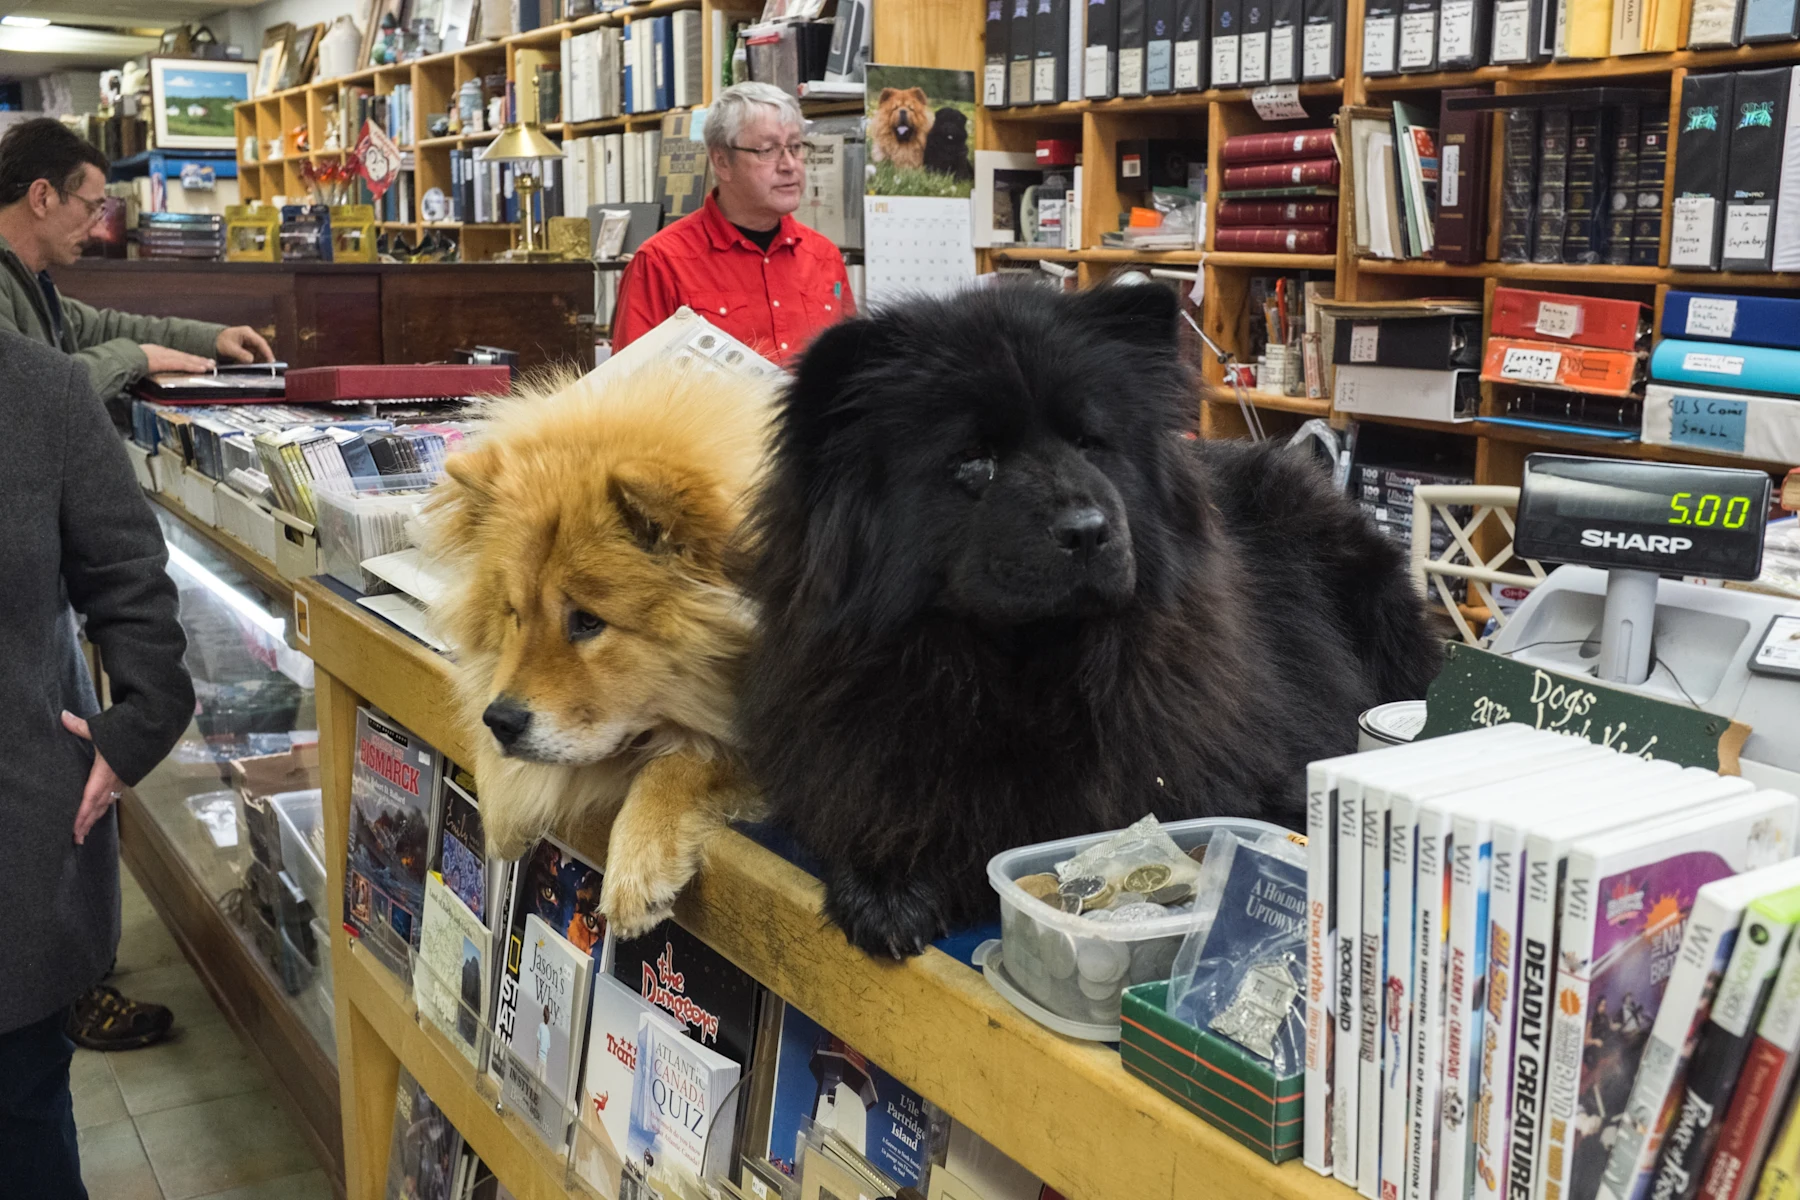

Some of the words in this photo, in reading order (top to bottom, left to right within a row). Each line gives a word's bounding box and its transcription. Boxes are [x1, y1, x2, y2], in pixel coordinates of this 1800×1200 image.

[1362, 467, 1379, 480] 100
[1363, 484, 1380, 497] 100
[1668, 492, 1751, 529] 5.00
[1580, 529, 1693, 554] SHARP
[1531, 669, 1598, 728] Dogs
[360, 737, 420, 797] BISMARCK
[1310, 791, 1323, 829] Wii
[1342, 799, 1356, 838] Wii
[1364, 810, 1378, 849] Wii
[1392, 825, 1407, 865] Wii
[1421, 836, 1436, 876] Wii
[1455, 845, 1471, 885] Wii
[1250, 879, 1262, 896] A
[1494, 852, 1511, 894] Wii
[1530, 861, 1548, 903] Wii
[1245, 895, 1295, 934] UPTOWN
[1568, 878, 1589, 921] Wii
[1422, 909, 1431, 956] NARUTO
[1682, 923, 1713, 969] Wii
[530, 941, 565, 996] Jason's
[656, 942, 685, 994] the
[1451, 947, 1466, 1002] ACADEMY
[535, 974, 560, 1026] Why
[641, 960, 719, 1044] Dungeons
[1520, 937, 1546, 1053] DEADLY
[1417, 1030, 1427, 1064] CLASH
[1447, 1018, 1463, 1080] CHAMPIONS
[654, 1059, 706, 1112] CANADA
[1417, 1067, 1425, 1082] OF
[652, 1078, 704, 1140] QUIZ
[1415, 1085, 1424, 1118] NINJA
[891, 1121, 918, 1152] Island
[1411, 1121, 1422, 1190] REVOLUTION
